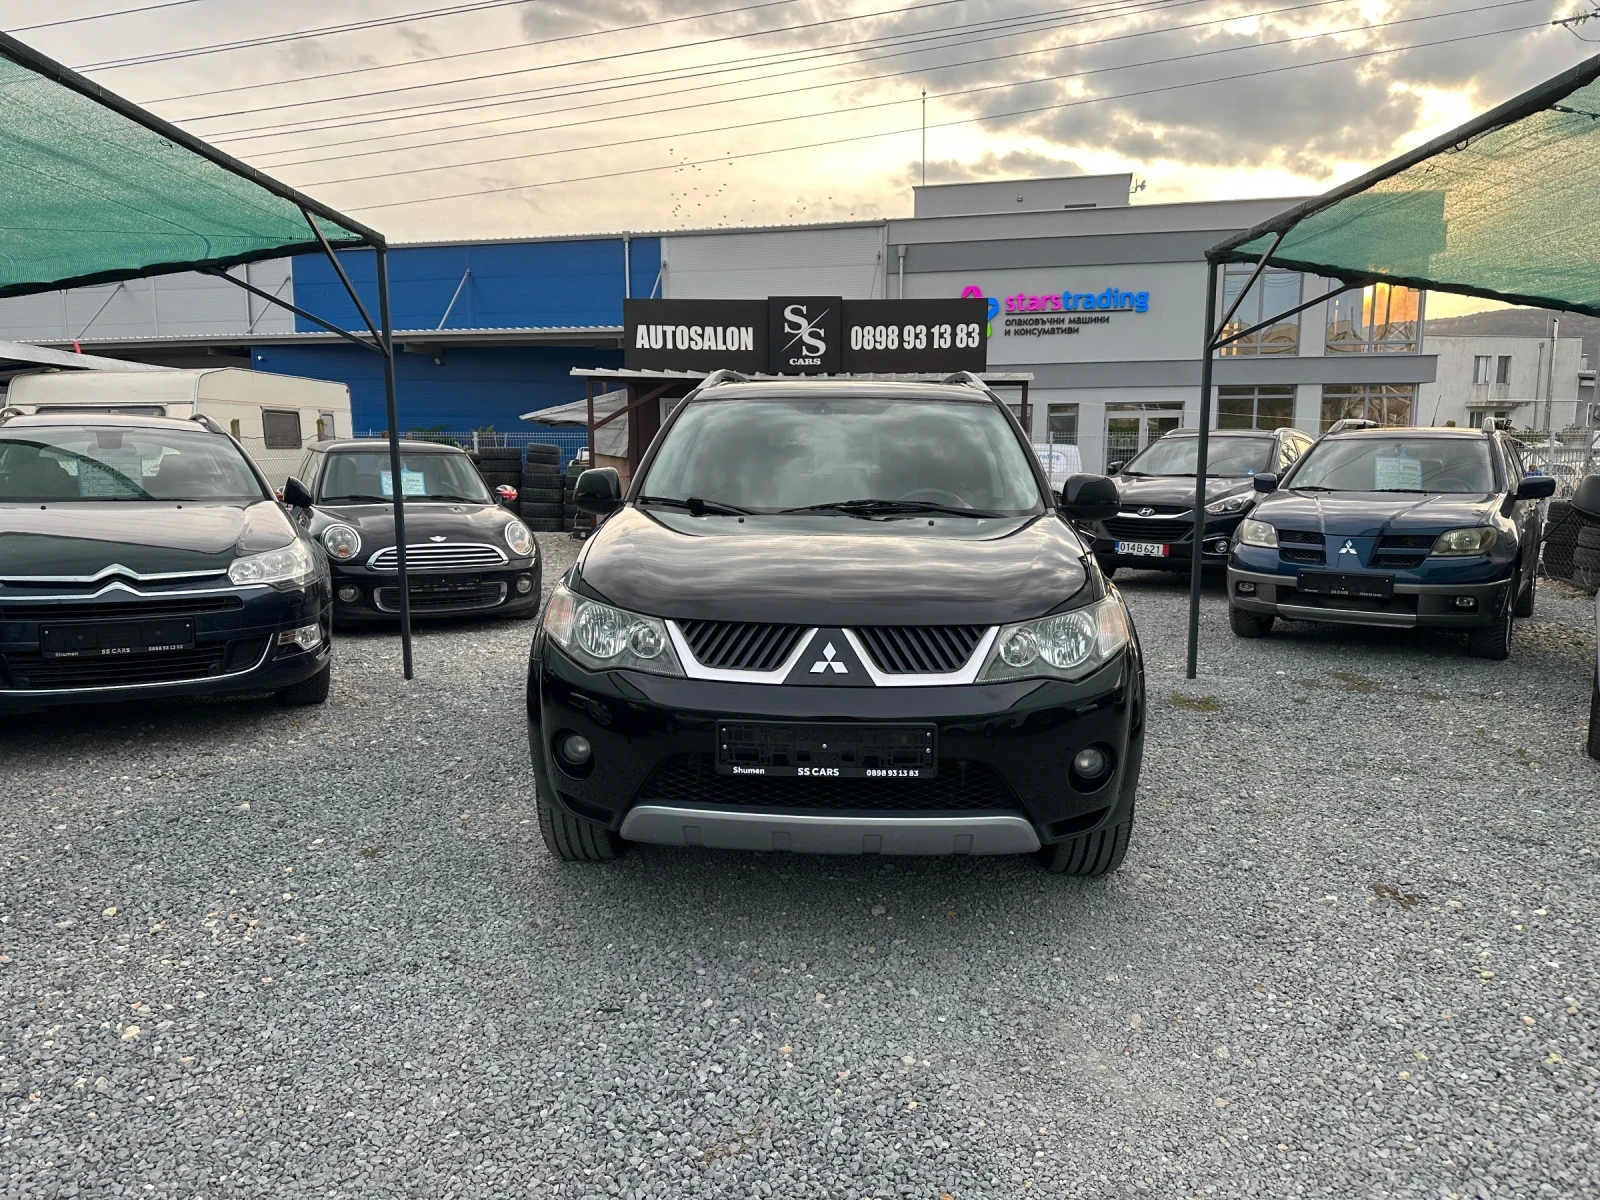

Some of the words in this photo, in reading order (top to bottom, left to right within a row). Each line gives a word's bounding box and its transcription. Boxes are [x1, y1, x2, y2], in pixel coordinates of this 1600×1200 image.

[1004, 287, 1150, 313] starstrading
[1005, 317, 1065, 327] опаковъчни
[1068, 315, 1110, 324] машини
[635, 324, 754, 351] AUTOSALON
[850, 325, 899, 350] 0898
[902, 324, 927, 350] 93
[930, 324, 952, 349] 13
[955, 323, 980, 348] 83
[1004, 328, 1011, 336] и
[1014, 326, 1080, 337] консумативи
[789, 357, 822, 366] CARS
[732, 766, 765, 775] Shumen
[797, 767, 811, 776] SS
[811, 768, 840, 776] CARS
[866, 769, 887, 777] 0898
[887, 769, 898, 777] 93
[898, 769, 908, 777] 13
